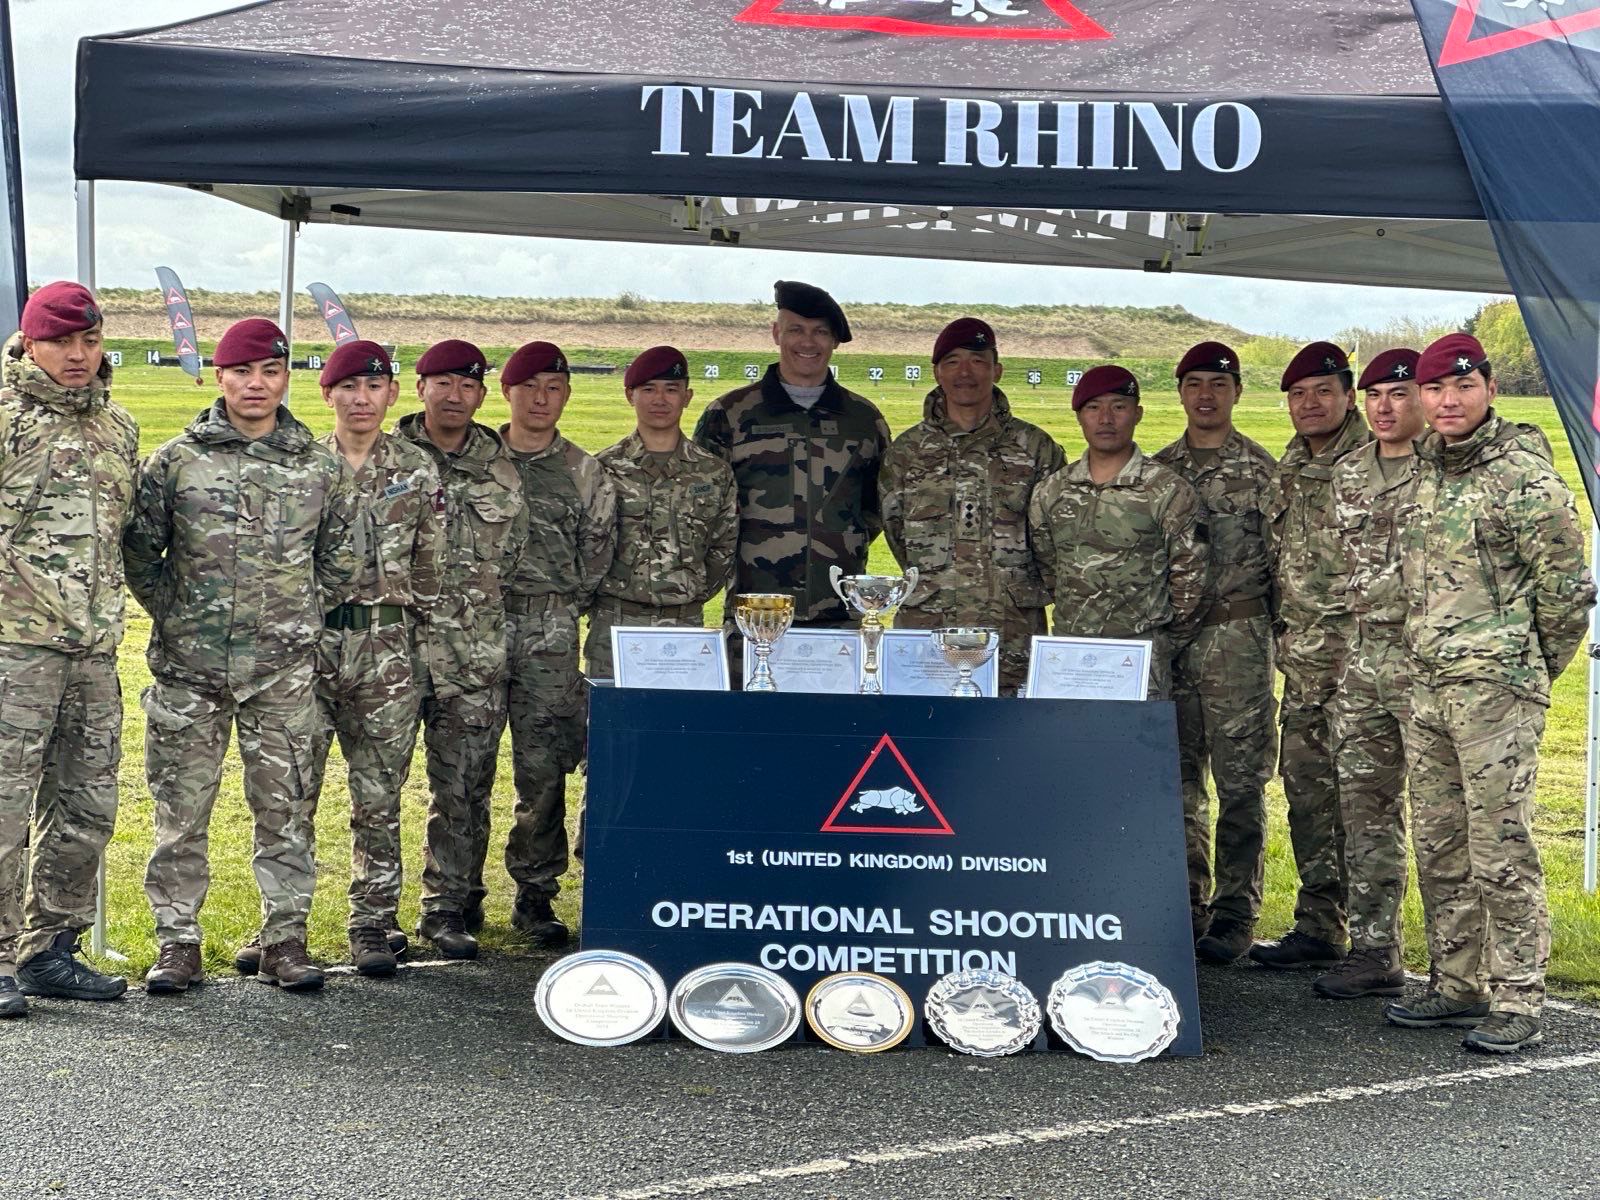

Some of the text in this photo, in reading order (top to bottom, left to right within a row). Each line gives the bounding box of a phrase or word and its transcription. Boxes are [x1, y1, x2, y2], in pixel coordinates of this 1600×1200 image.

[641, 85, 1262, 173] TEAM RHINO
[147, 350, 160, 364] 14
[704, 364, 719, 378] 28
[745, 365, 759, 378] 29
[869, 367, 884, 380] 32
[906, 366, 920, 379] 33
[1028, 371, 1041, 384] 36
[1068, 372, 1081, 384] 37
[386, 483, 409, 495] NISHAN
[727, 849, 1047, 873] 1st (UNITED KINGDOM) DIVISION
[651, 901, 1123, 941] OPERATIONAL SHOOTING
[760, 943, 1017, 978] COMPETITION
